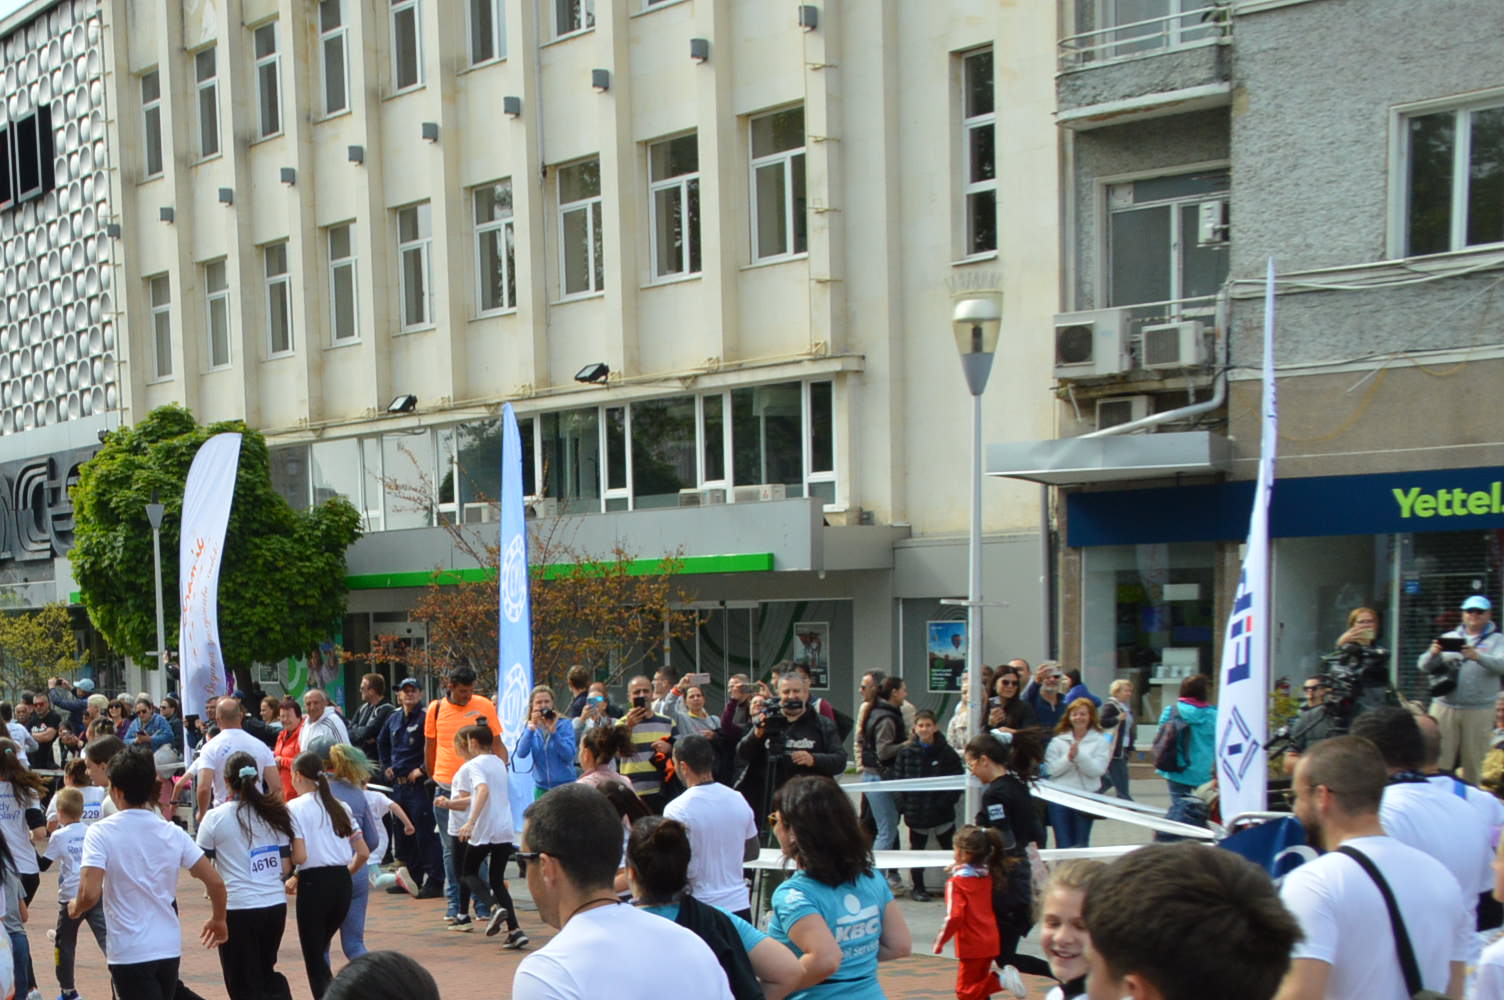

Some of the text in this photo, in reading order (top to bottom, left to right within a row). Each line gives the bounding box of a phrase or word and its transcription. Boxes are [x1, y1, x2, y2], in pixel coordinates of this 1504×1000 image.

[82, 809, 100, 820] 229
[252, 856, 278, 873] 4616
[837, 917, 880, 942] KBC
